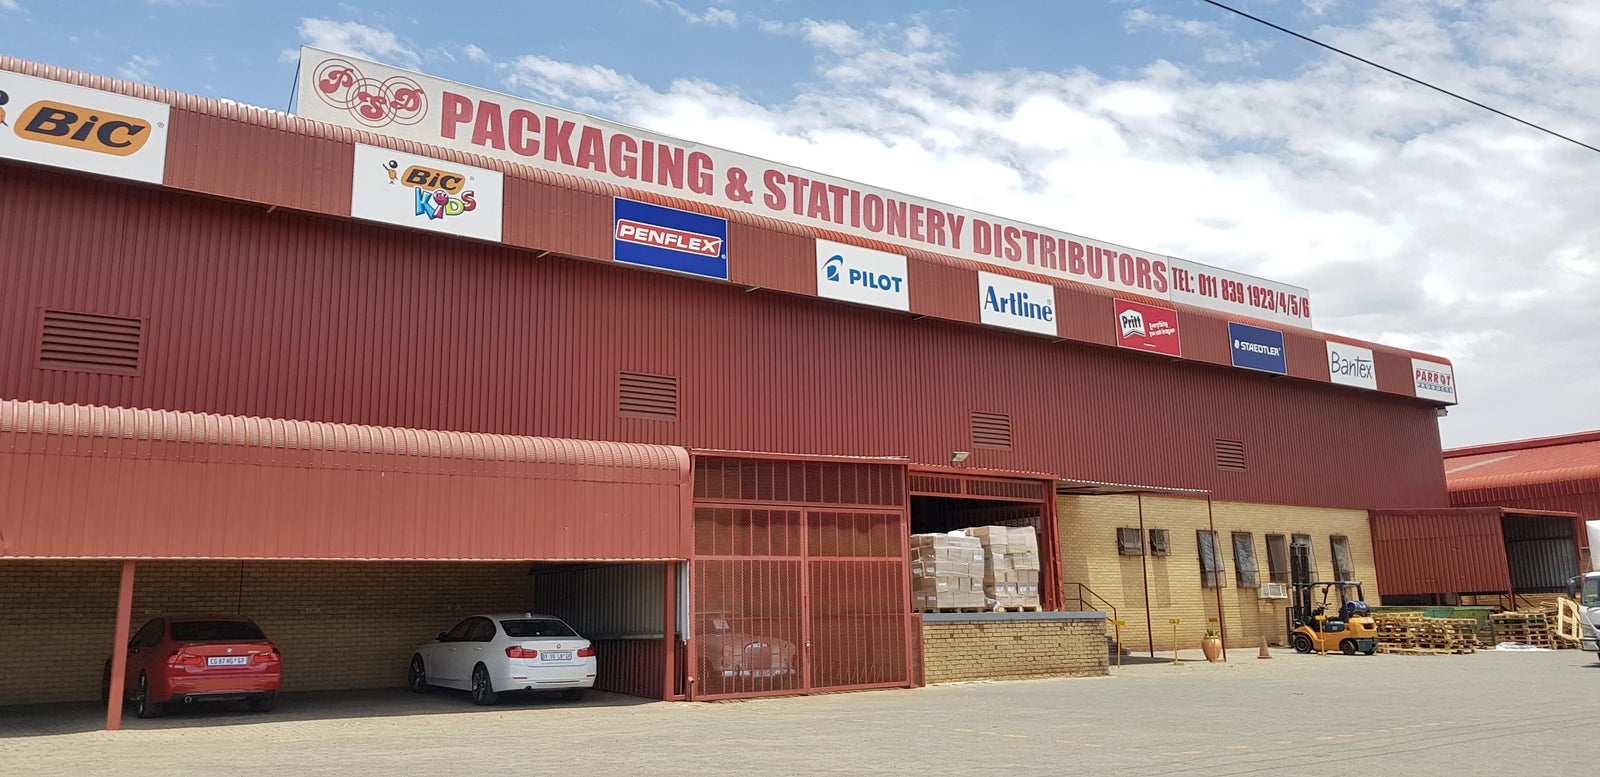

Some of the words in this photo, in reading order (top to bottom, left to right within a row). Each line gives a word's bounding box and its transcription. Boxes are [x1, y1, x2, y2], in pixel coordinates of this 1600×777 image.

[441, 91, 714, 196] PACKAGING
[724, 167, 753, 204] &
[763, 169, 965, 250] STATIONERY
[973, 218, 1168, 294] DISTRIBUTORS
[620, 224, 724, 253] PENFLEX
[849, 268, 903, 293] PILOT
[1171, 267, 1195, 293] TEL:
[1198, 273, 1218, 298] 011
[1221, 278, 1245, 304] 839
[1247, 284, 1310, 319] 1923/4/5/6
[984, 285, 1053, 322] Artline
[1122, 315, 1141, 329] Pritt
[1240, 341, 1280, 357] STAEDTLER
[1331, 351, 1373, 380] Bantex
[1416, 370, 1451, 385] PARROT
